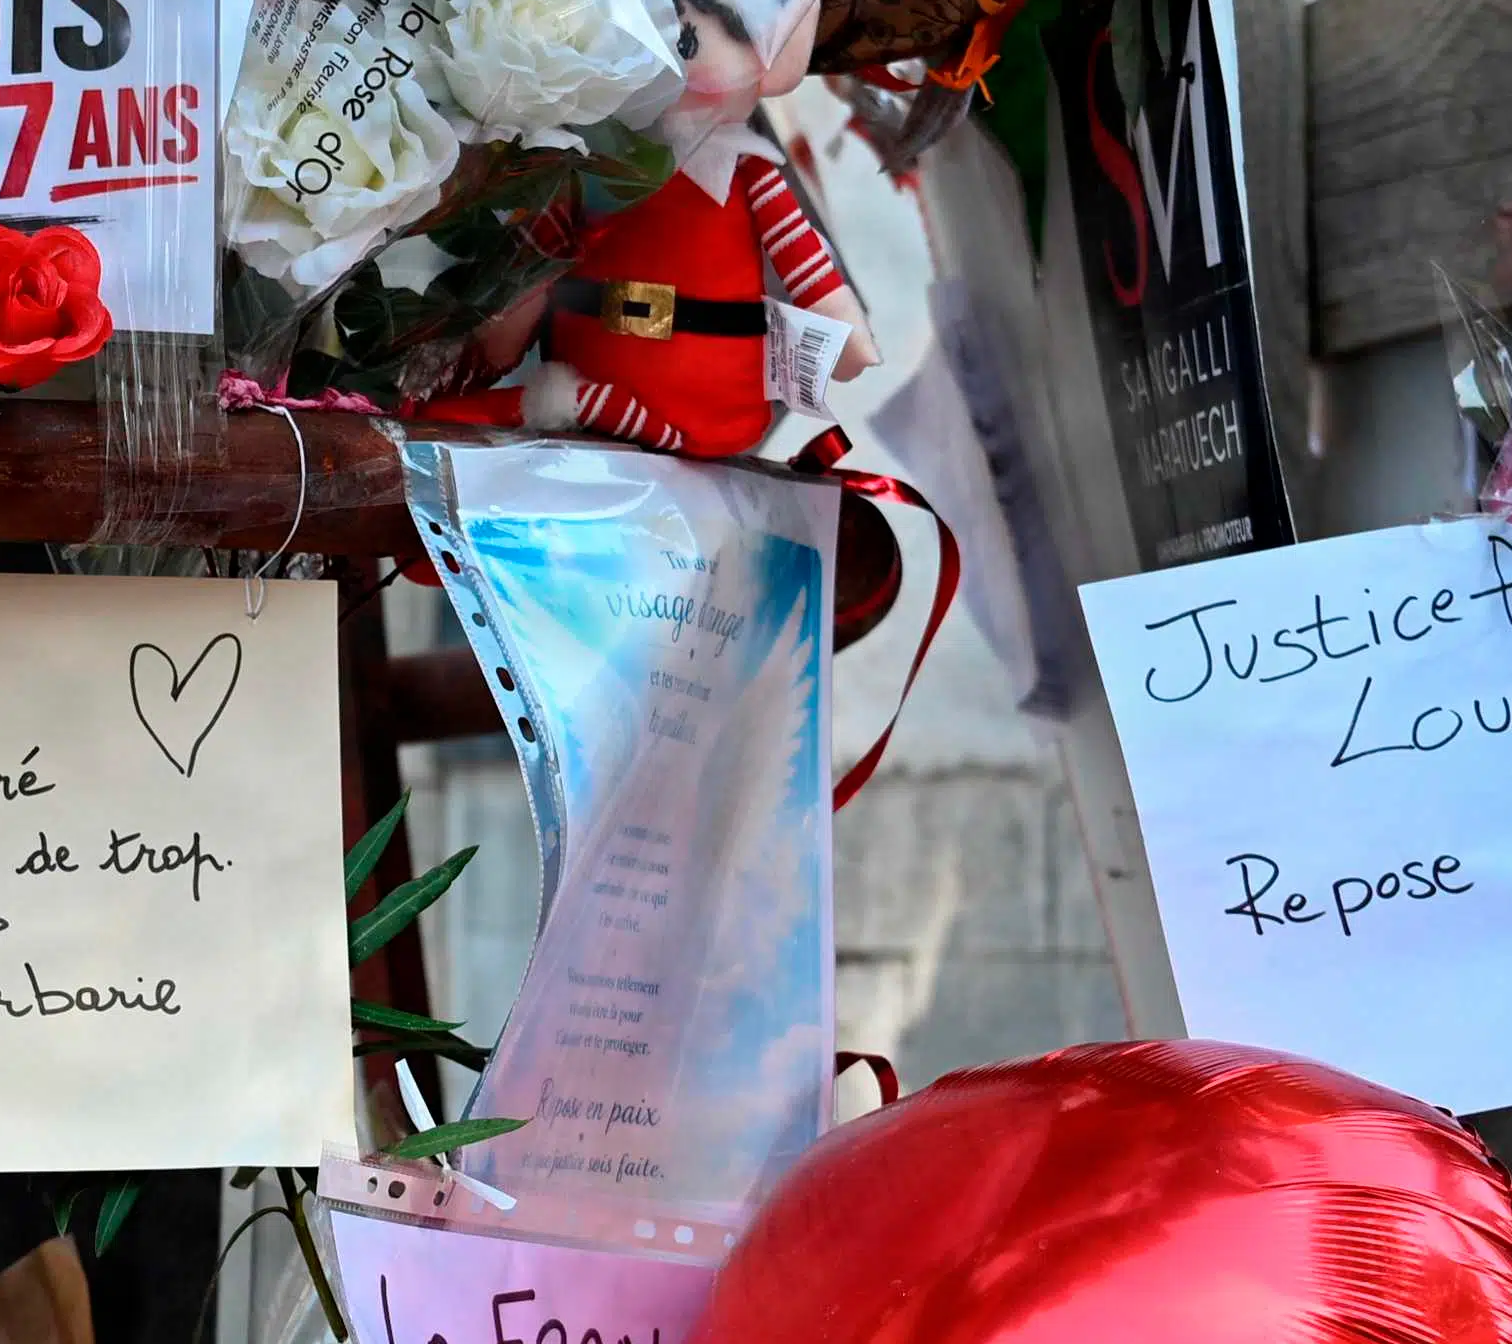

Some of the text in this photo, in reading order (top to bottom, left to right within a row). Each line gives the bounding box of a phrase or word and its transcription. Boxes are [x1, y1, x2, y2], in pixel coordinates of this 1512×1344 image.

[398, 2, 441, 38] la
[296, 51, 350, 114] Fleuriste
[342, 46, 414, 121] Rose
[68, 85, 199, 170] ANS
[285, 132, 345, 202] d'Or
[1121, 315, 1232, 413] SANGALLI
[606, 584, 695, 643] visage
[1144, 588, 1454, 702] Justice
[16, 834, 81, 877] de
[1225, 853, 1475, 938] Repose
[604, 1098, 661, 1135] paix
